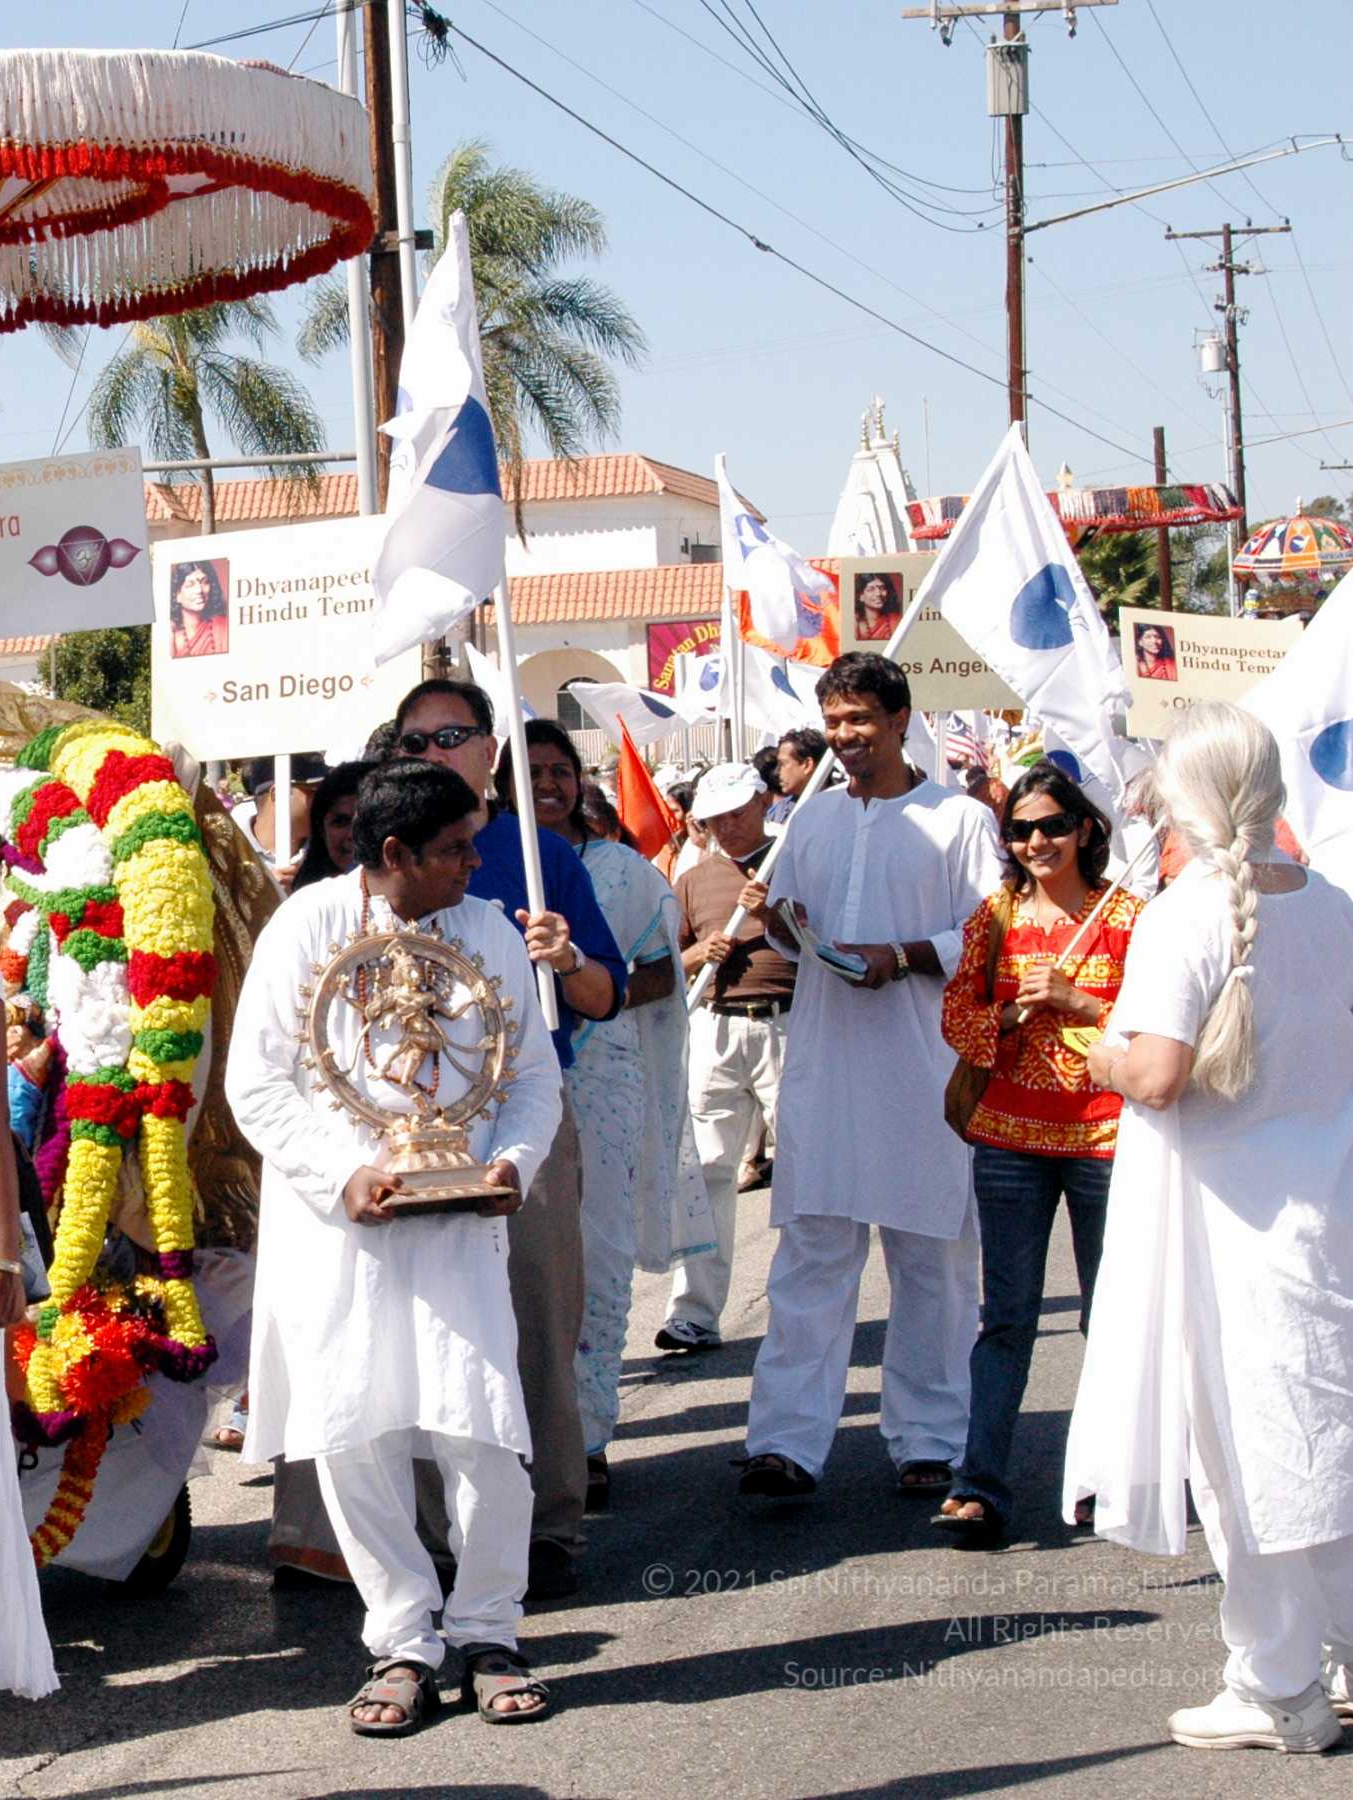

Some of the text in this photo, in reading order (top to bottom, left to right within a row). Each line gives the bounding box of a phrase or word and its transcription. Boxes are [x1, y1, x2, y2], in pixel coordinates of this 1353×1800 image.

[238, 601, 308, 626] Hindu
[900, 661, 923, 674] os
[1182, 655, 1277, 675] Hindu Tem
[222, 673, 354, 703] San Diego
